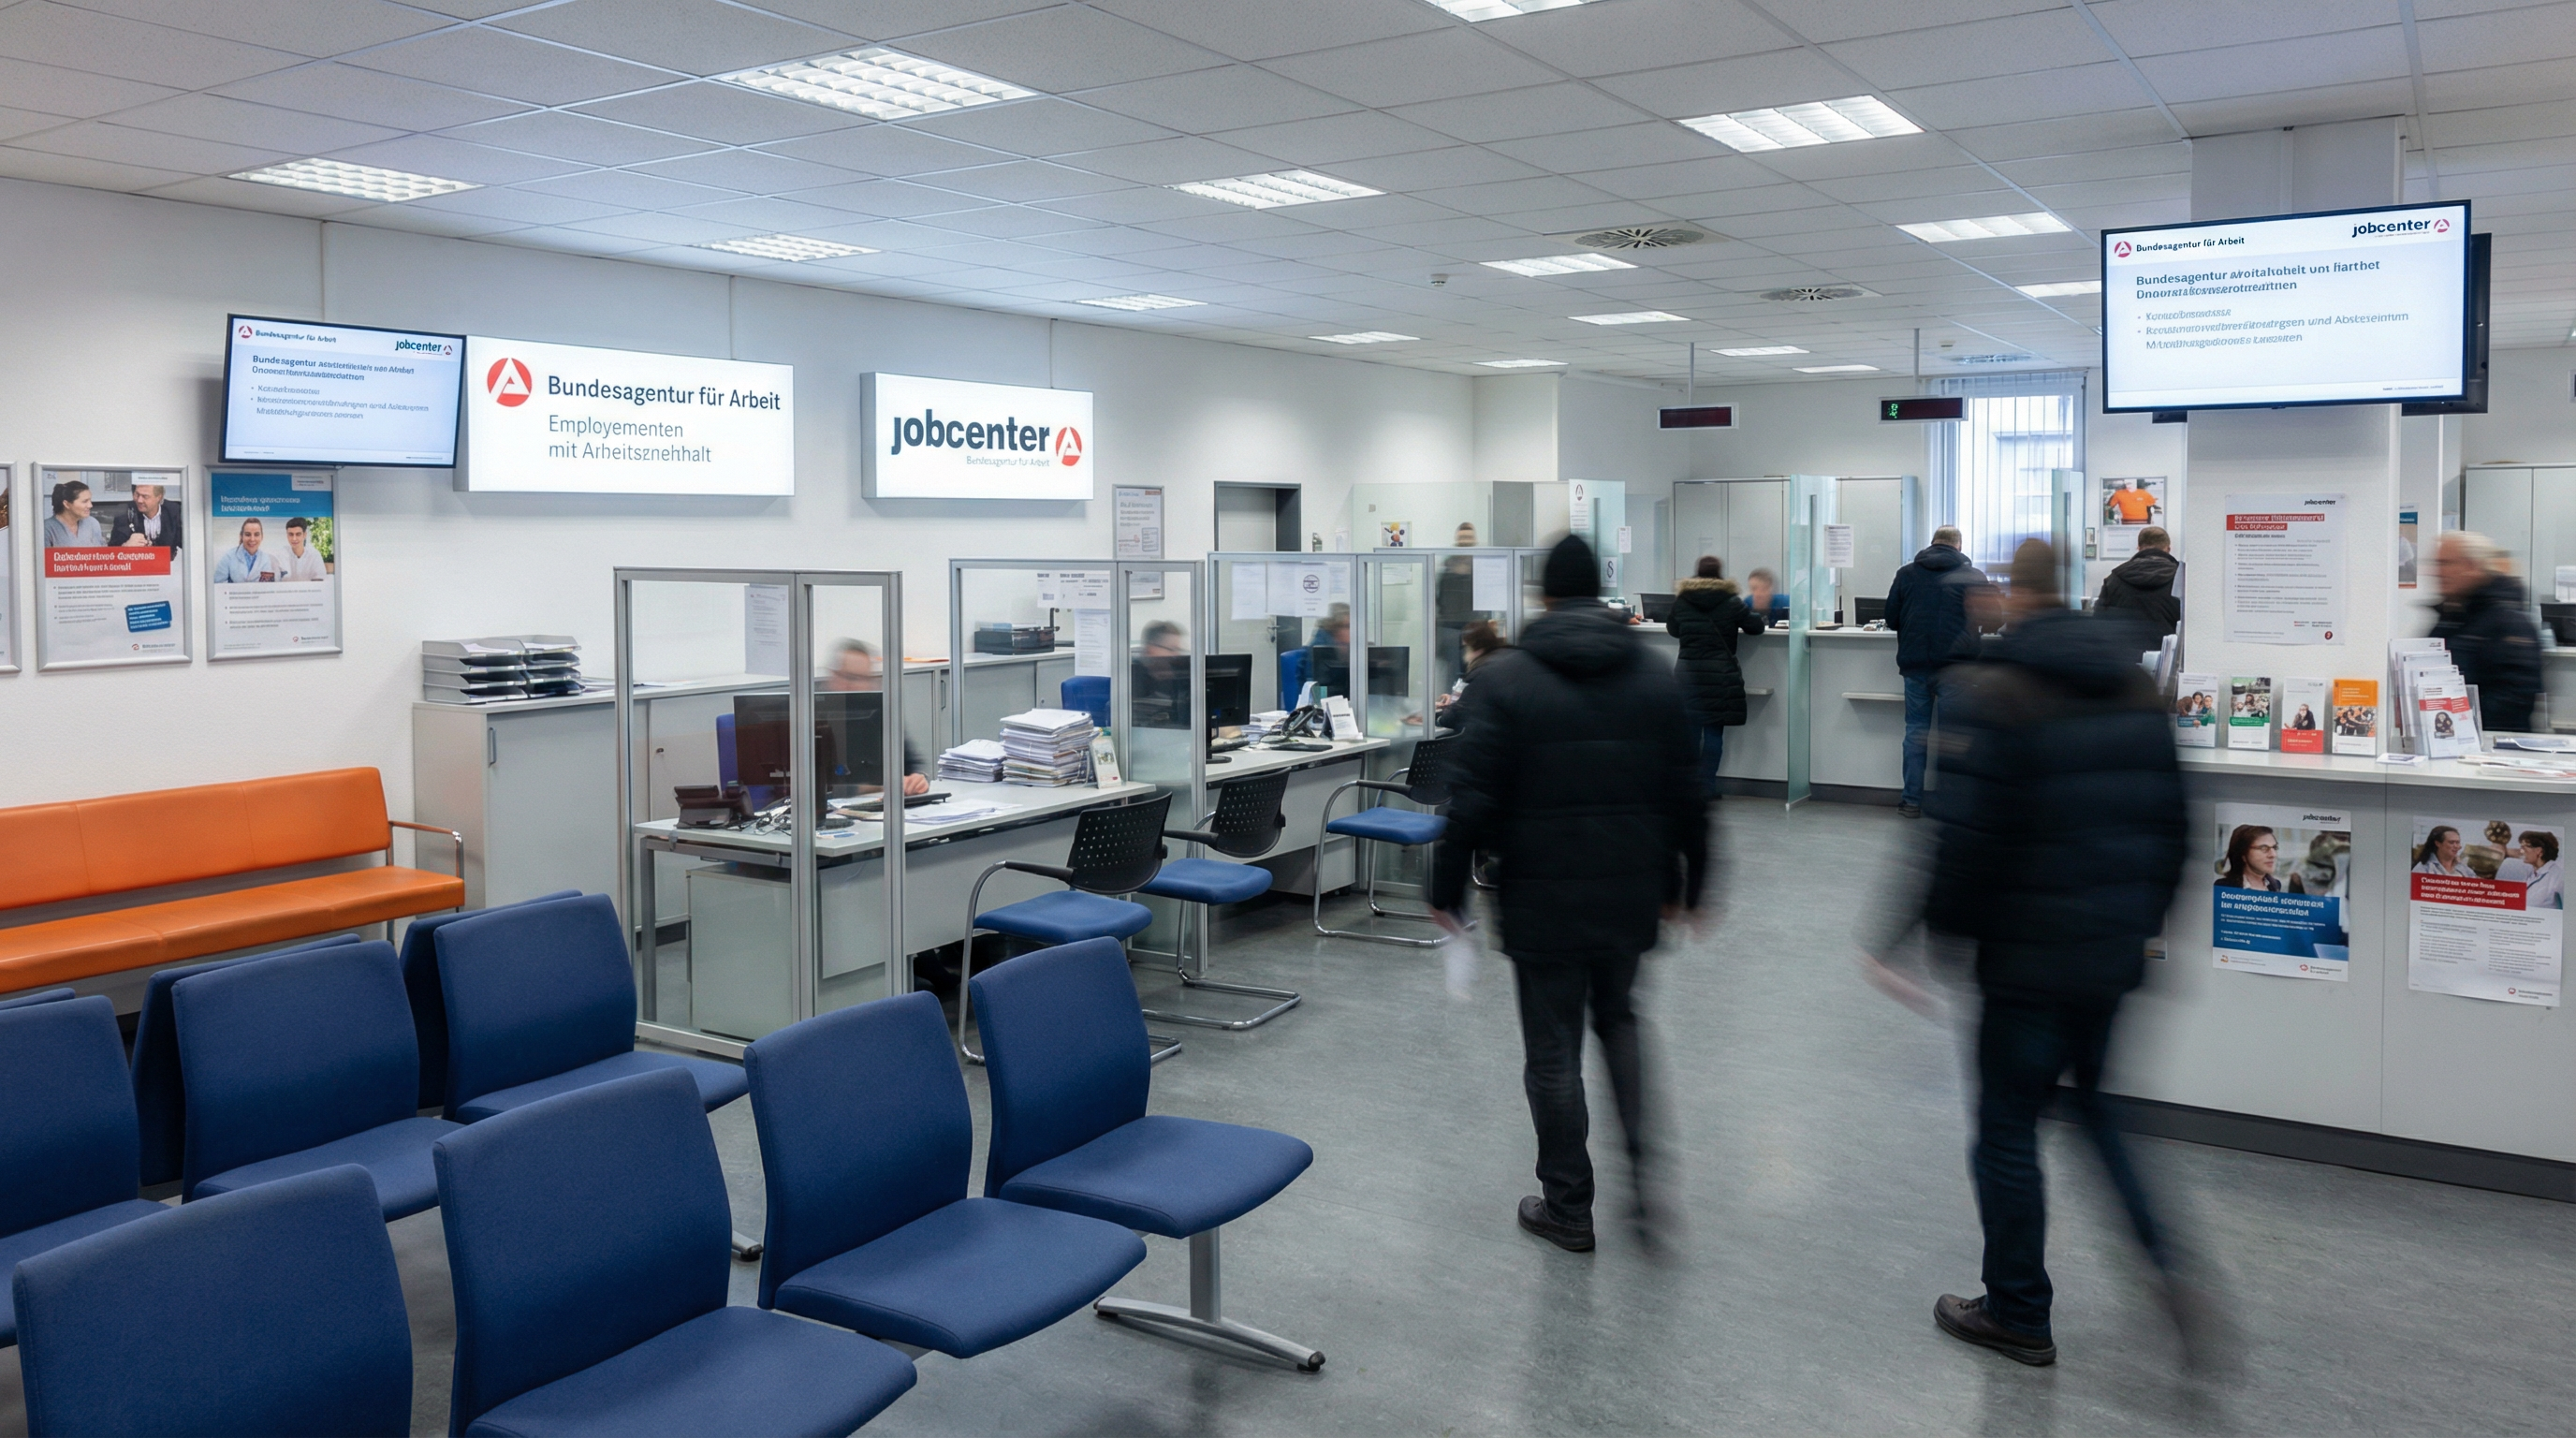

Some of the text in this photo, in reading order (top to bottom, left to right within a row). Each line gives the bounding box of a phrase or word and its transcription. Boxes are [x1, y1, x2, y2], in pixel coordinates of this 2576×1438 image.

[2351, 219, 2431, 238] jobcenter
[2136, 240, 2201, 252] Bundesagentur
[2217, 236, 2245, 246] Arbeit
[2136, 271, 2228, 286] Bundesagentur
[395, 339, 442, 352] jobcenter
[253, 355, 316, 367] Bundesagentur
[549, 375, 781, 411] Bundesagentur für Arbeit
[549, 415, 683, 439] Employementen
[891, 408, 1050, 455] jobcenter
[549, 441, 578, 459] mit
